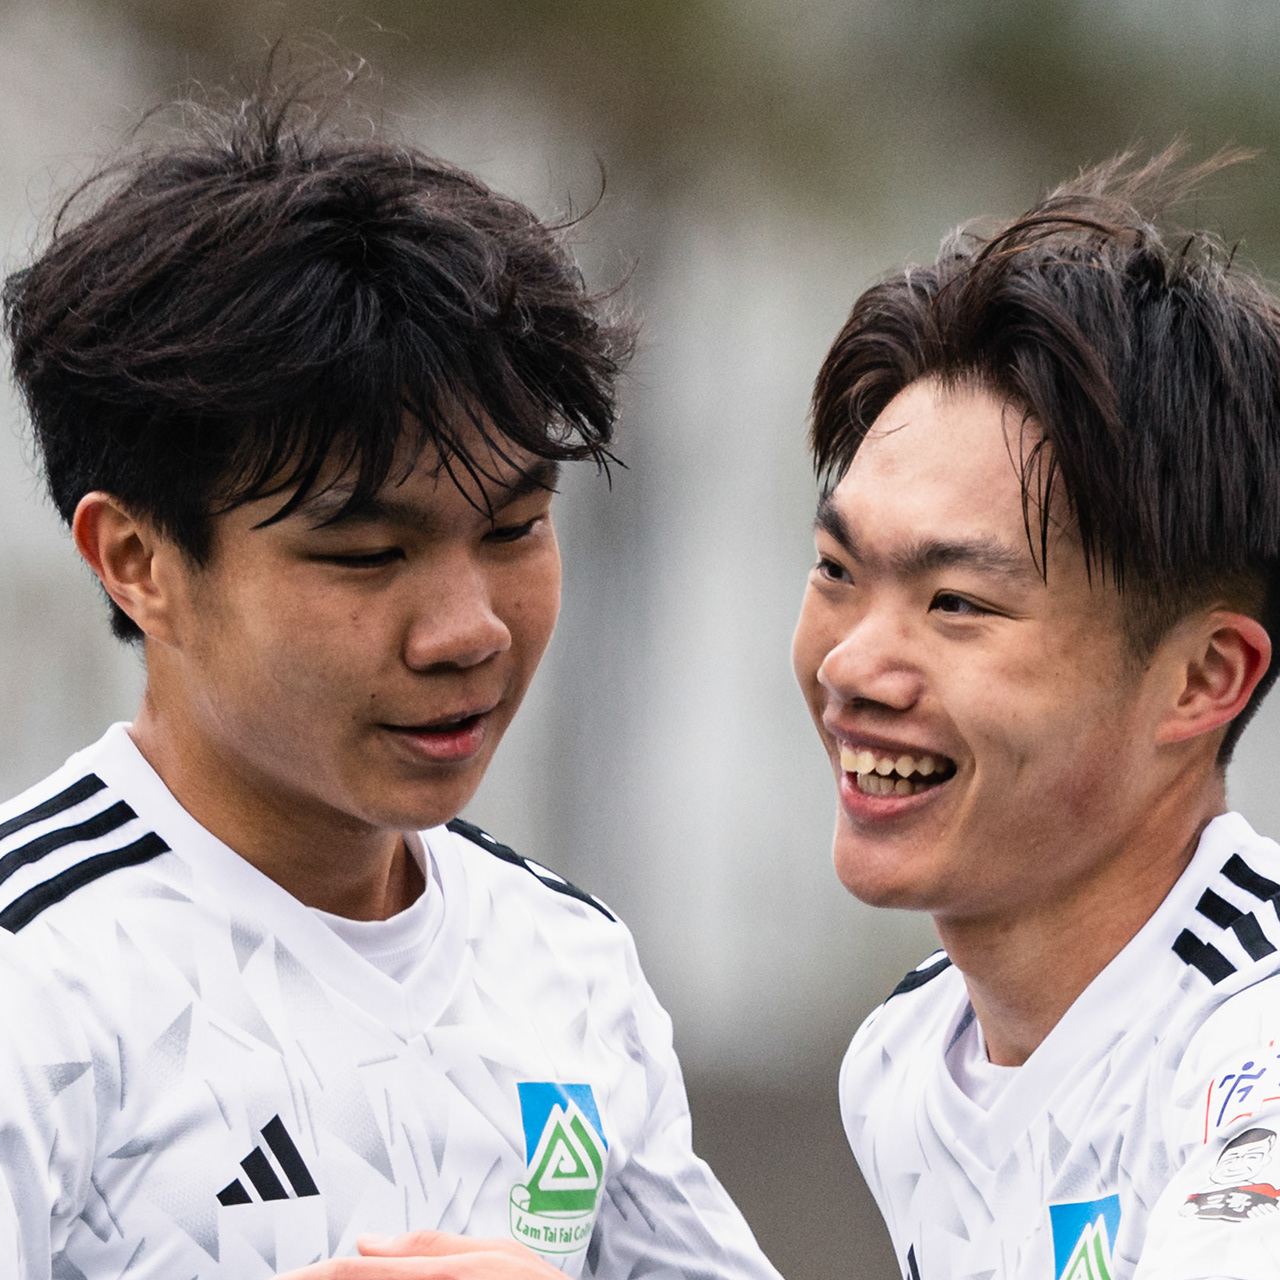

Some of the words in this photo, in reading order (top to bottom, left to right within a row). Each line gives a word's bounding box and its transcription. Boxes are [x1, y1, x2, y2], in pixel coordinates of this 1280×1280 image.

[516, 1216, 541, 1240] Lam
[543, 1226, 557, 1243] Tai
[559, 1227, 573, 1243] Fai
